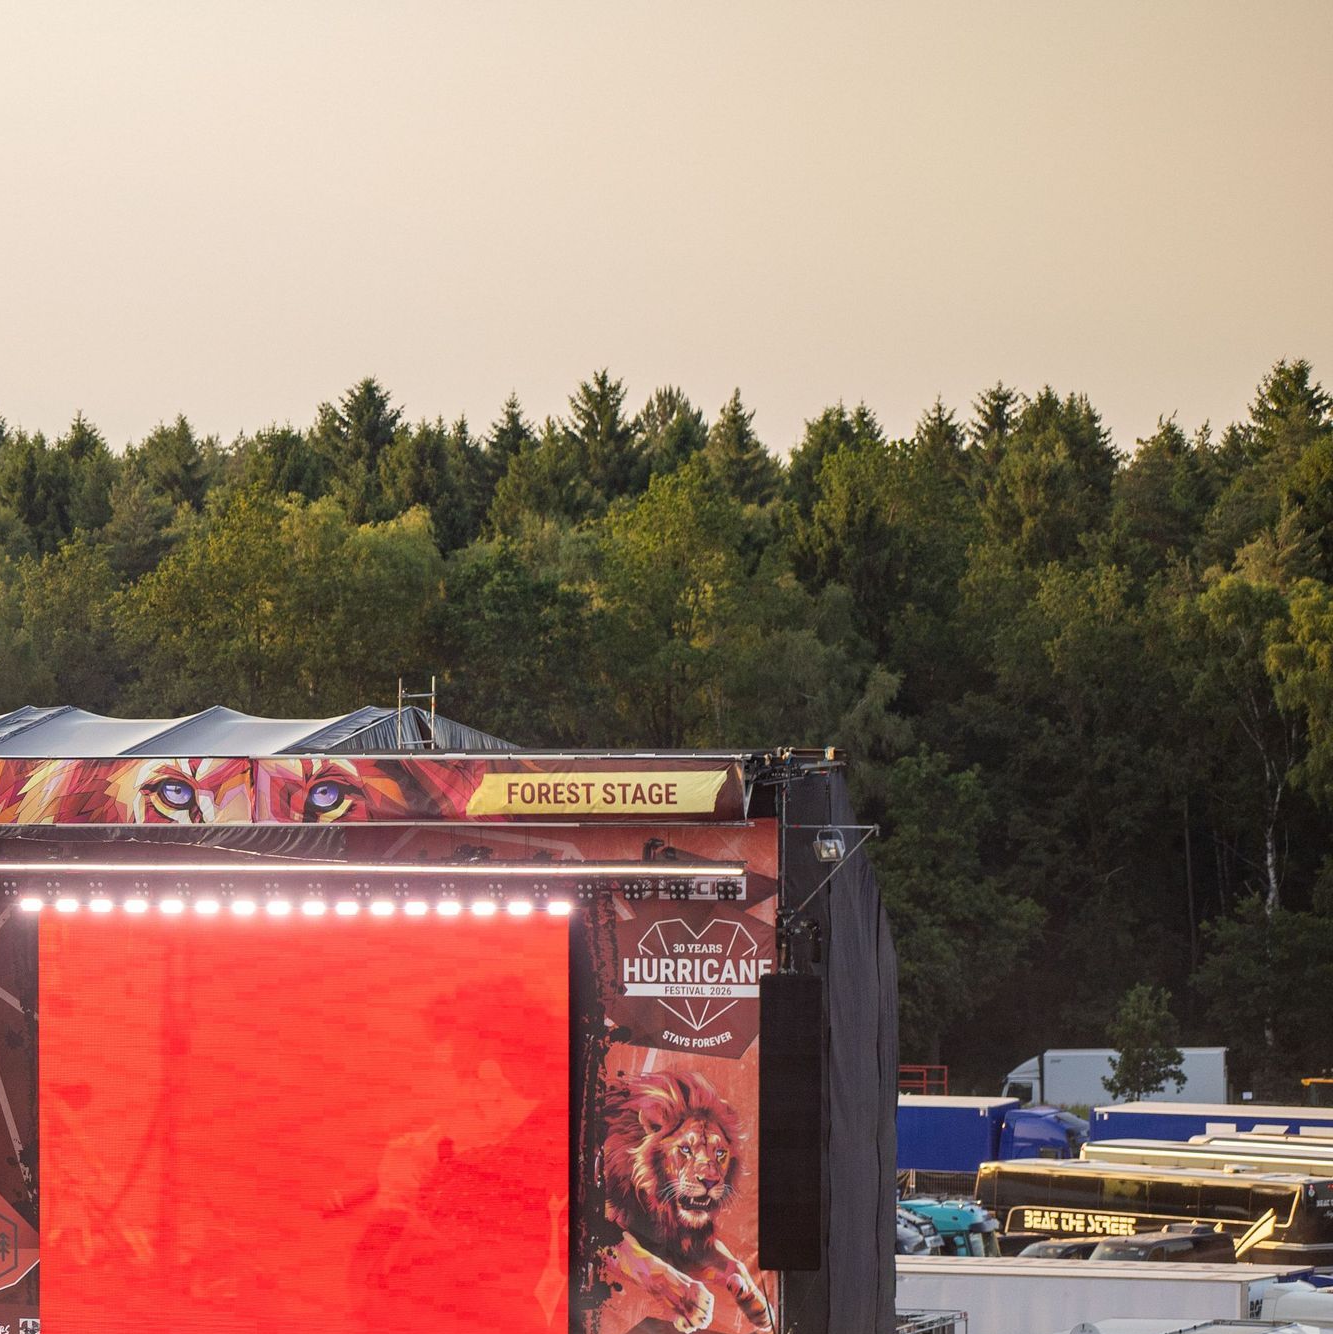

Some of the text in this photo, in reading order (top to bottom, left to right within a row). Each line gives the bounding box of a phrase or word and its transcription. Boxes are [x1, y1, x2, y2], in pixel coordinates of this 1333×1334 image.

[507, 783, 677, 805] FOREST STAGE
[673, 944, 723, 954] 30 YEARS
[664, 986, 732, 996] FESTIVAL 2026
[662, 1030, 733, 1048] STAYS FOREVER
[1060, 1212, 1086, 1232] THE
[1087, 1214, 1137, 1236] STREET
